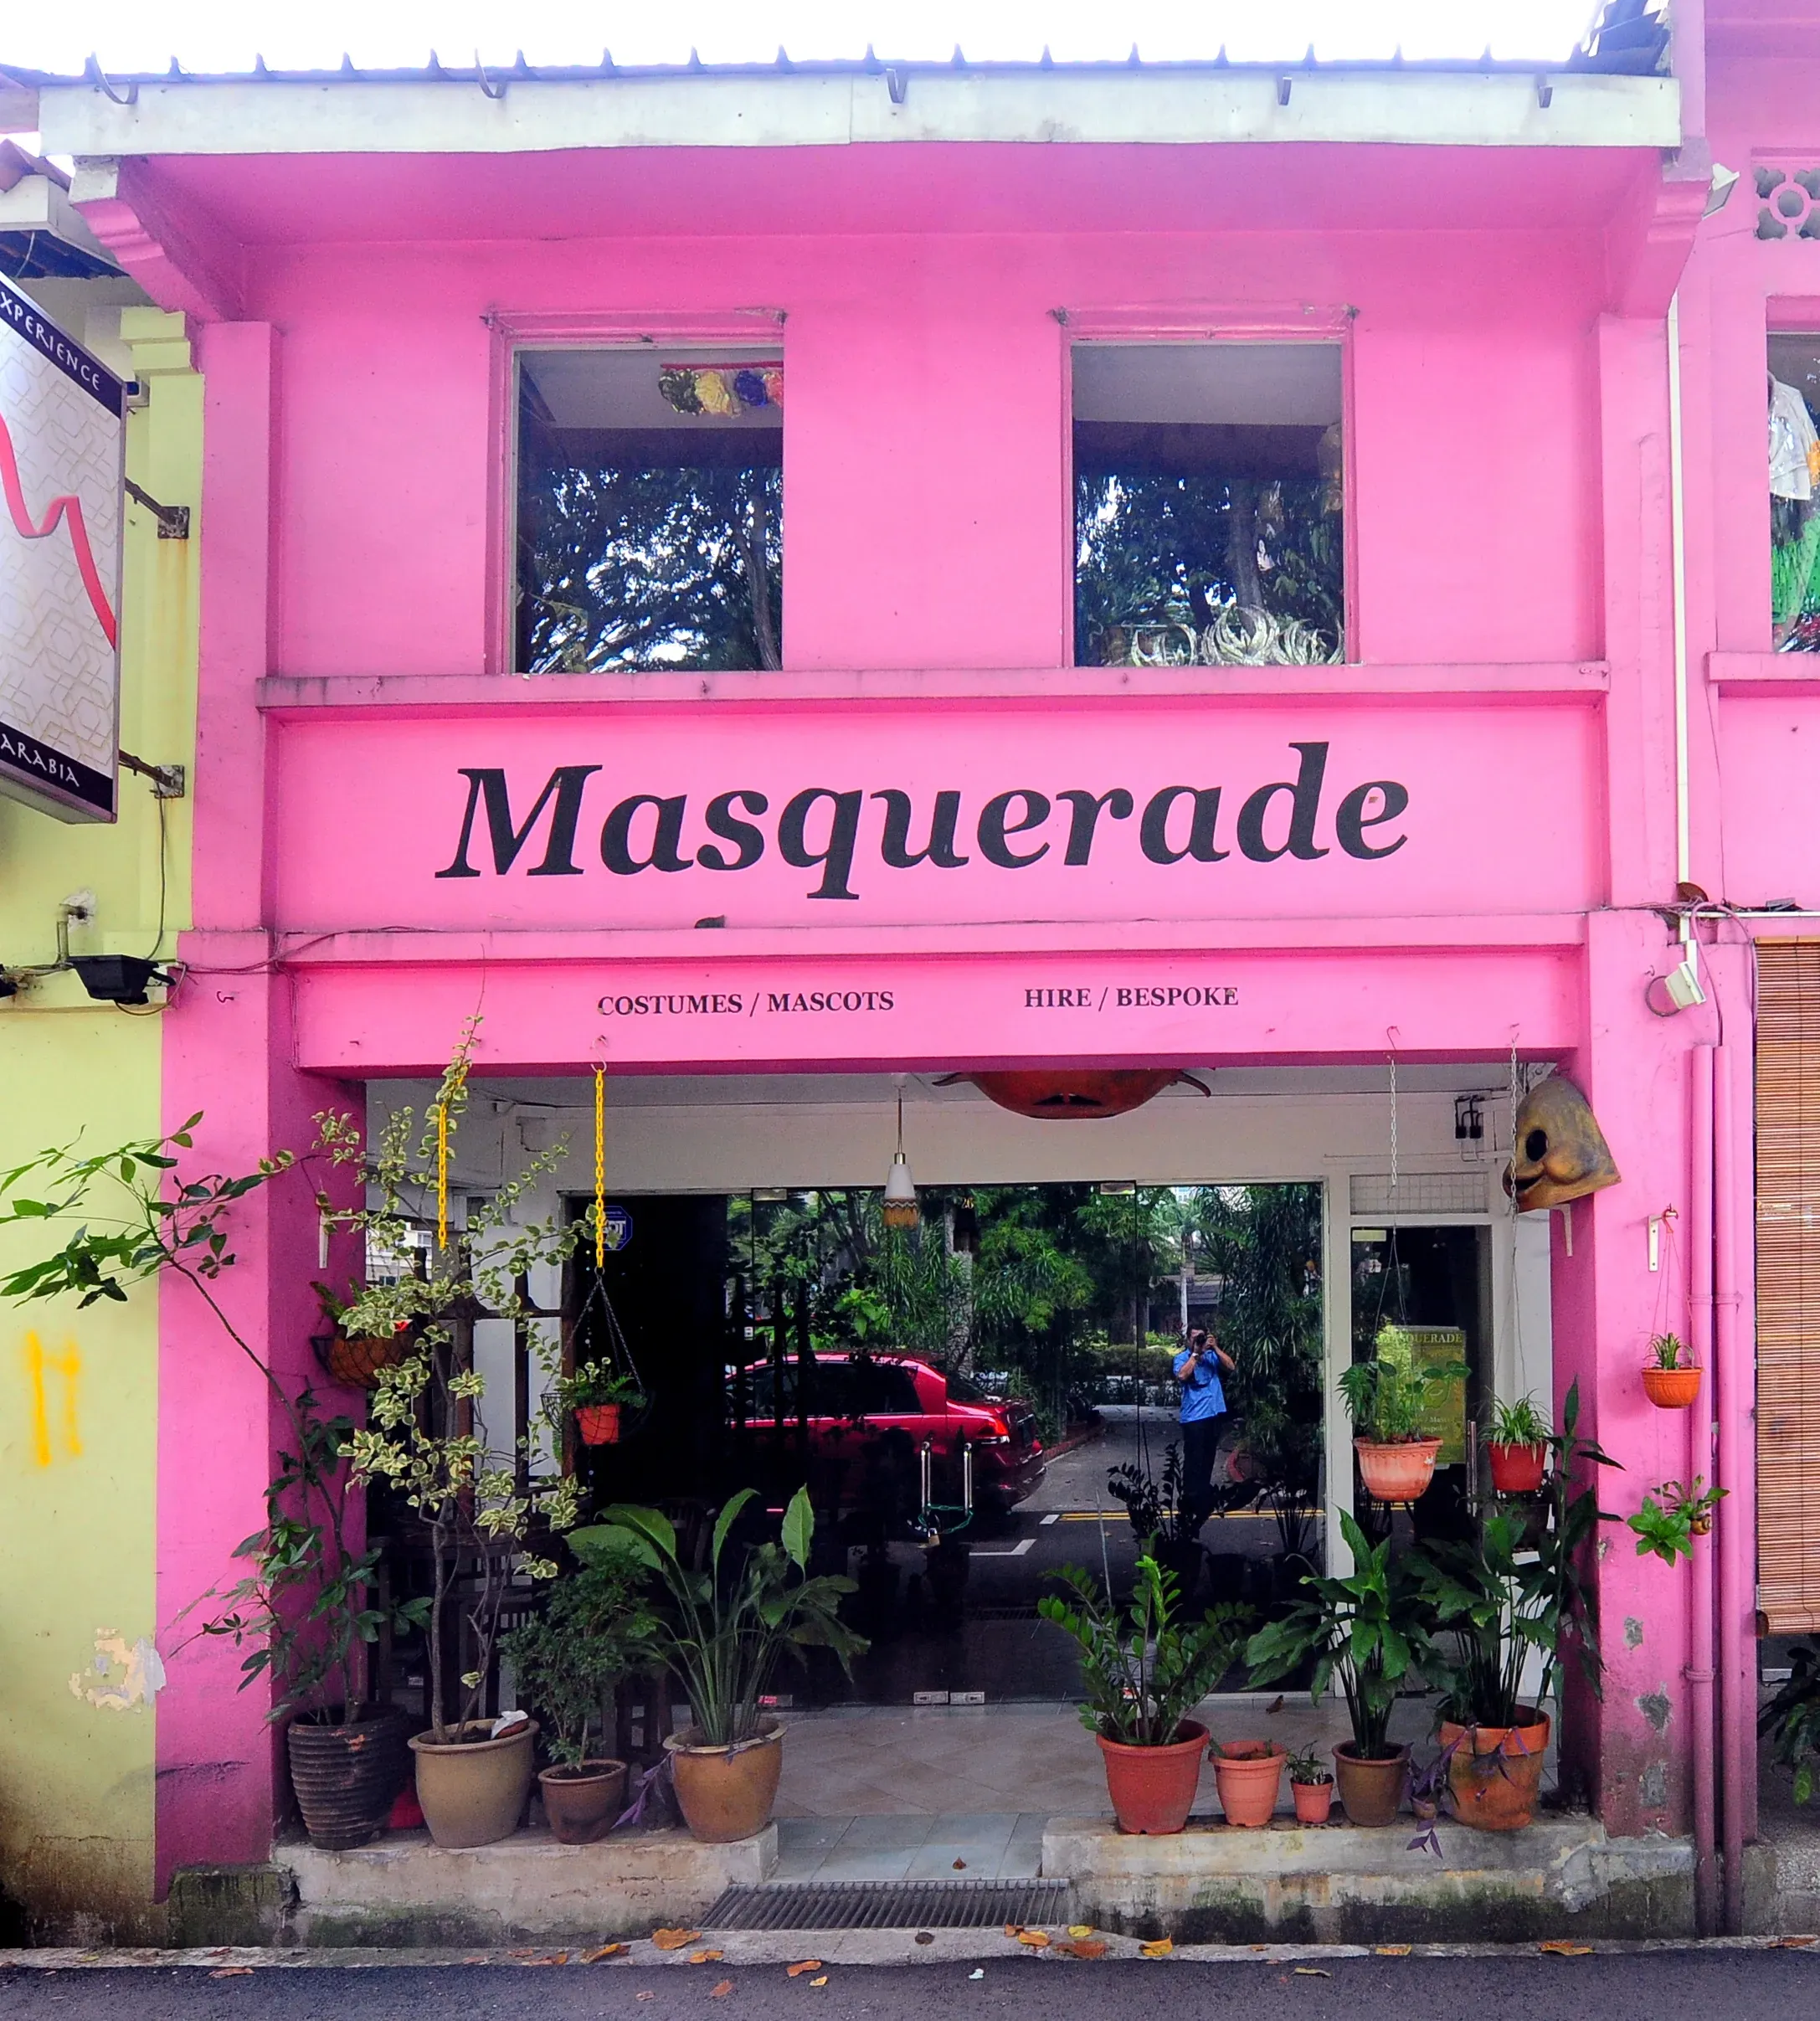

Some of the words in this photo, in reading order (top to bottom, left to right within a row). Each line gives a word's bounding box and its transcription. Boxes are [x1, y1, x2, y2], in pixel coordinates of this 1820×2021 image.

[1, 733, 80, 787] ARABIA
[434, 742, 1410, 900] Masquerade
[597, 994, 743, 1016] COSTUMES
[749, 992, 760, 1018] /
[767, 991, 894, 1012] MASCOTS
[1025, 988, 1092, 1007] HIRE
[1098, 987, 1108, 1012] /
[1116, 986, 1239, 1006] BESPOKE
